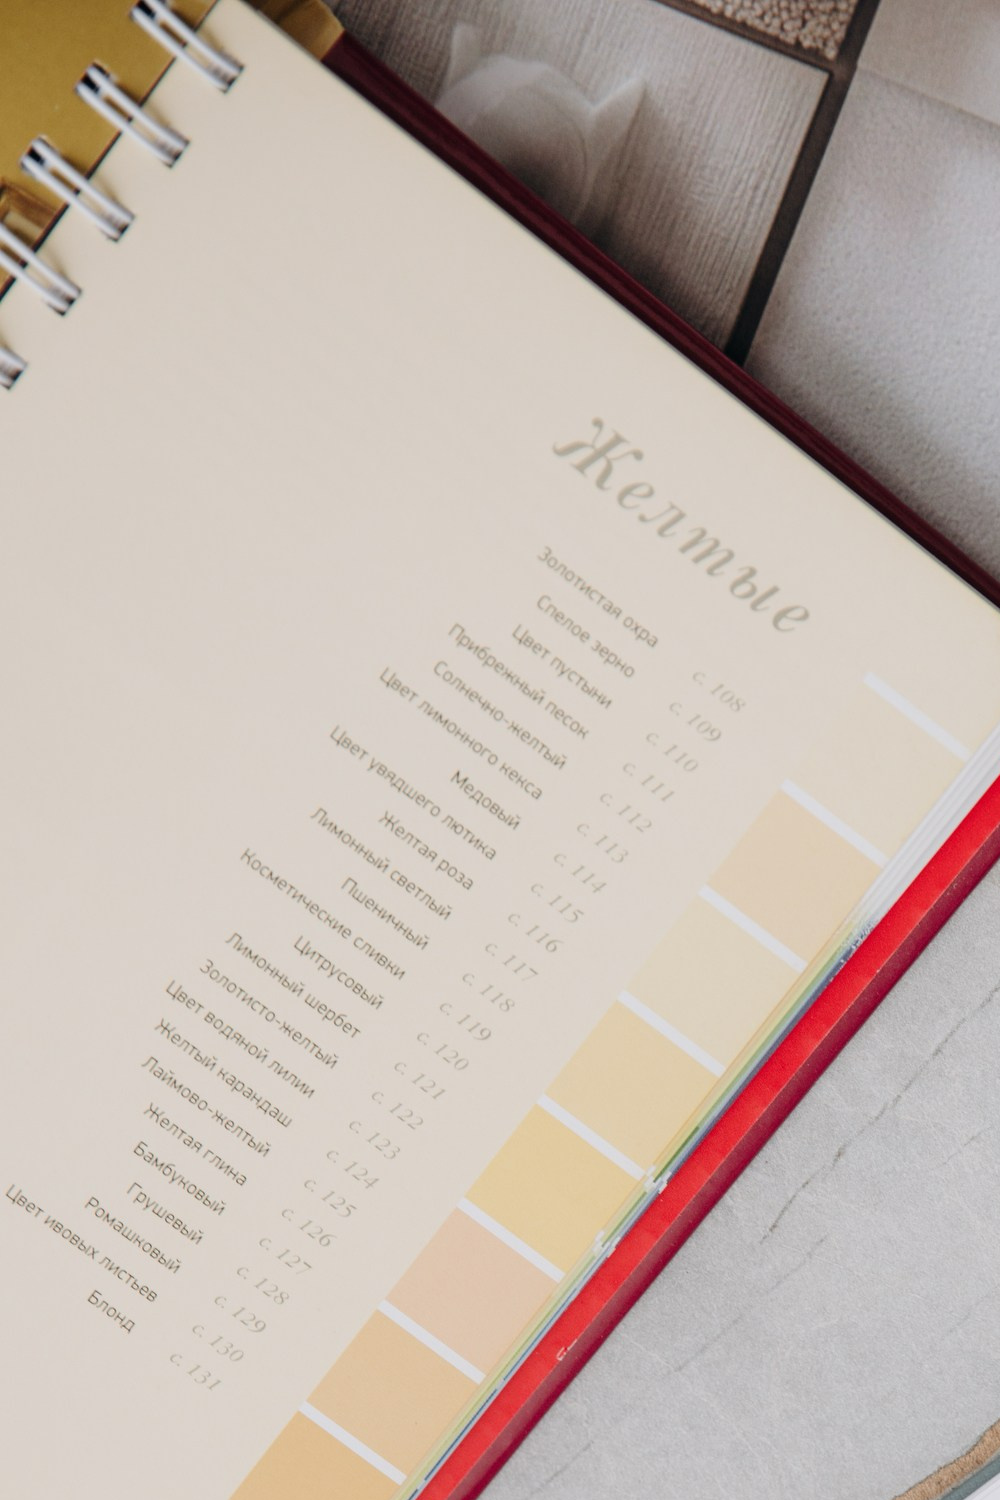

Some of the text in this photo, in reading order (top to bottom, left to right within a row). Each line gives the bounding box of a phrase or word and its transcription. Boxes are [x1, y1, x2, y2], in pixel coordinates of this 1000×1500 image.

[551, 416, 811, 633] Желтые
[446, 621, 547, 706] Прибрежный
[543, 699, 590, 740] песок
[639, 772, 675, 803] 111
[510, 622, 552, 660] Цвет
[548, 655, 613, 710] пустыни
[662, 742, 700, 773] 110
[535, 593, 591, 644] Спелое
[589, 638, 636, 679] зерно
[685, 712, 723, 743] 109
[536, 545, 623, 620] Золотистая
[621, 615, 659, 649] охра
[708, 681, 747, 713] 108
[328, 723, 370, 761] Цвет
[365, 756, 442, 818] увядшего
[439, 813, 497, 861] лютика
[546, 893, 585, 924] 115
[378, 665, 419, 703] Цвет
[416, 699, 499, 766] лимонного
[497, 761, 543, 801] кекса
[592, 832, 630, 864] 113
[432, 659, 568, 771] Солнечно-желтый
[616, 803, 653, 834] 112
[308, 805, 391, 874] Лимонный
[388, 868, 453, 921] светлый
[500, 952, 540, 981] 117
[376, 809, 439, 863] Желтая
[433, 857, 475, 891] роза
[524, 923, 564, 954] 116
[448, 768, 522, 831] Медовый
[569, 863, 608, 894] 114
[223, 930, 306, 998] Лимонный
[302, 992, 362, 1039] шербет
[410, 1071, 447, 1101] 121
[238, 846, 353, 940] Косметические
[351, 935, 406, 981] сливки
[455, 1012, 493, 1042] 119
[291, 933, 385, 1011] Цитрусовый
[432, 1042, 470, 1072] 120
[339, 875, 430, 951] Пшеничный
[478, 982, 516, 1013] 118
[152, 1016, 219, 1072] Желтый
[215, 1066, 293, 1129] карандаш
[342, 1159, 381, 1190] 124
[164, 978, 206, 1015] Цвет
[202, 1009, 270, 1064] водяной
[266, 1058, 316, 1100] лилии
[365, 1130, 402, 1160] 123
[197, 957, 340, 1070] Золотисто-желтый
[387, 1100, 425, 1131] 122
[131, 1139, 227, 1217] Бамбуковый
[274, 1247, 314, 1275] 127
[139, 1054, 272, 1158] Лаймово-желтый
[319, 1188, 358, 1219] 125
[141, 1100, 204, 1154] Желтая
[200, 1147, 248, 1187] глина
[297, 1218, 337, 1248] 126
[3, 1182, 45, 1218] Цвет
[42, 1213, 100, 1261] ивовых
[96, 1254, 159, 1303] листьев
[208, 1334, 245, 1363] 130
[82, 1194, 182, 1275] Ромашковый
[230, 1305, 268, 1334] 129
[125, 1180, 205, 1246] Грушевый
[252, 1276, 291, 1306] 128
[85, 1287, 137, 1335] Блонд
[185, 1362, 222, 1391] 131
